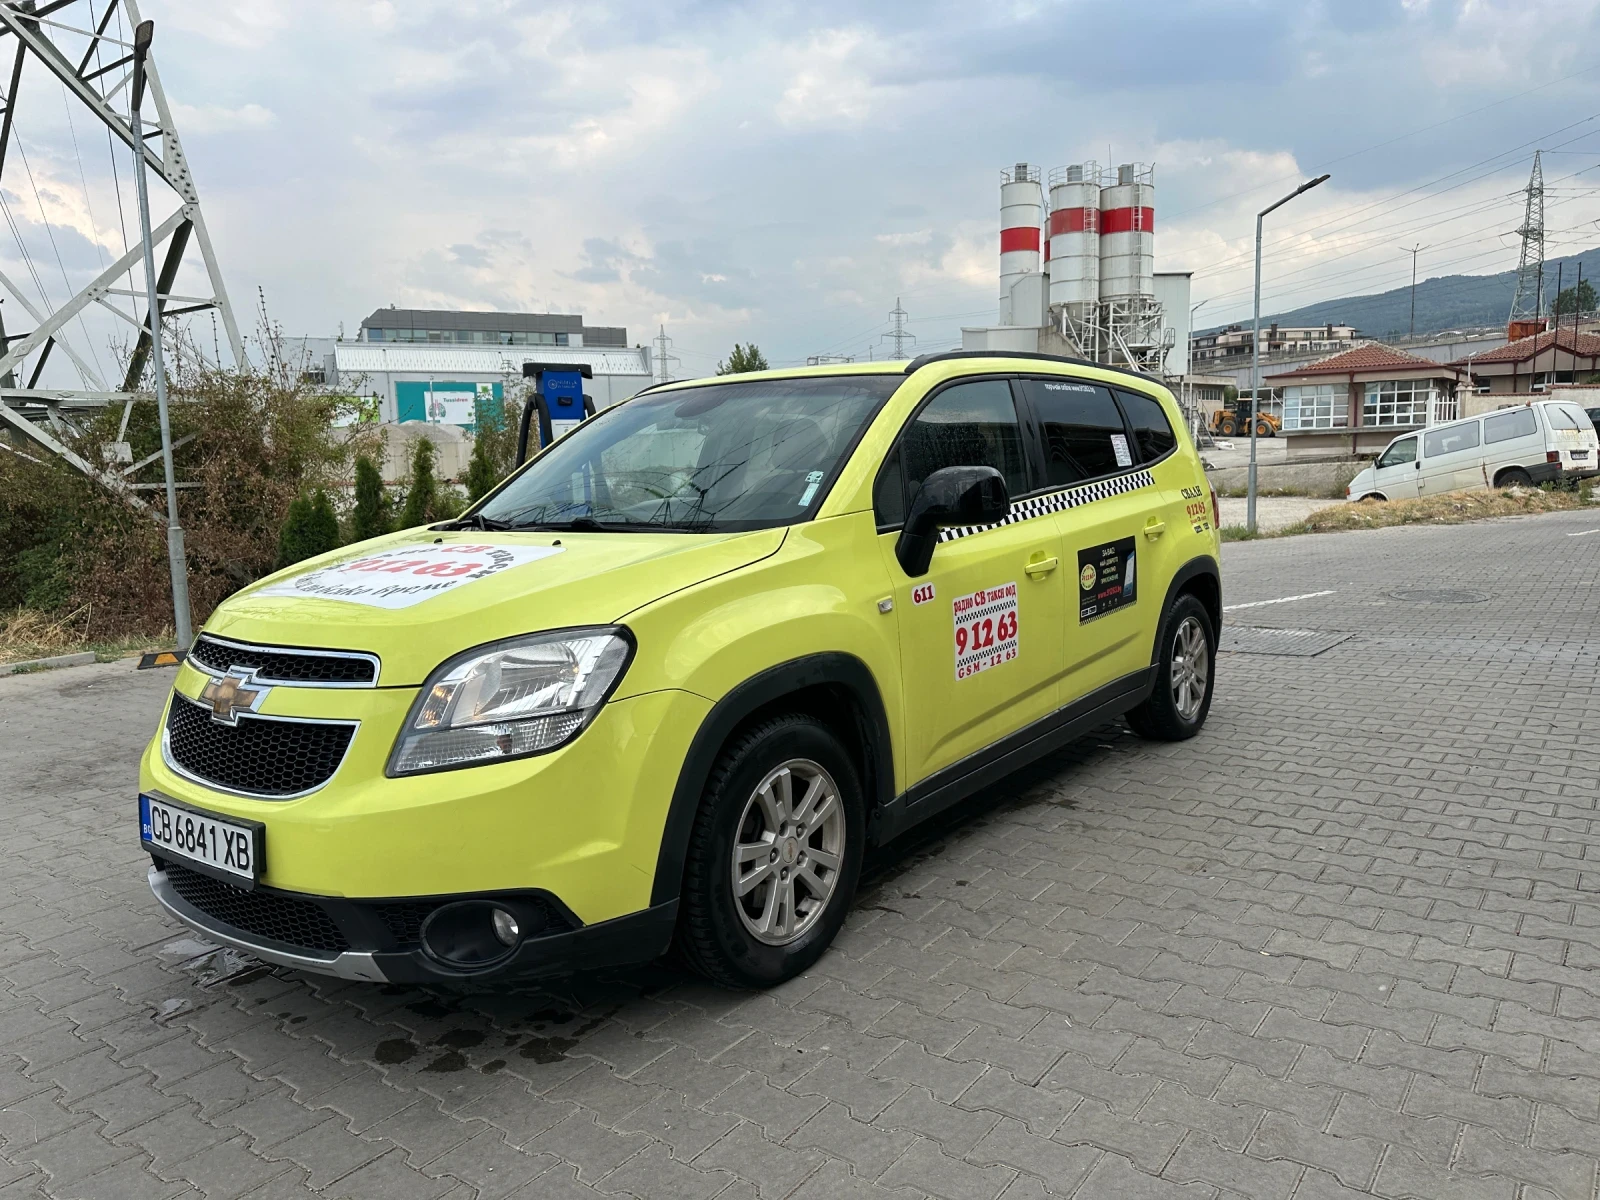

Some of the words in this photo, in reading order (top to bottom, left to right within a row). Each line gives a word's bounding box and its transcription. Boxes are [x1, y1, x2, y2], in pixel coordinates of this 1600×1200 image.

[1186, 501, 1206, 518] 91263
[441, 545, 494, 554] СВ
[913, 585, 934, 604] 611
[974, 590, 986, 607] СВ
[958, 661, 980, 679] GSM
[143, 823, 152, 834] BG
[175, 814, 217, 861] 6841
